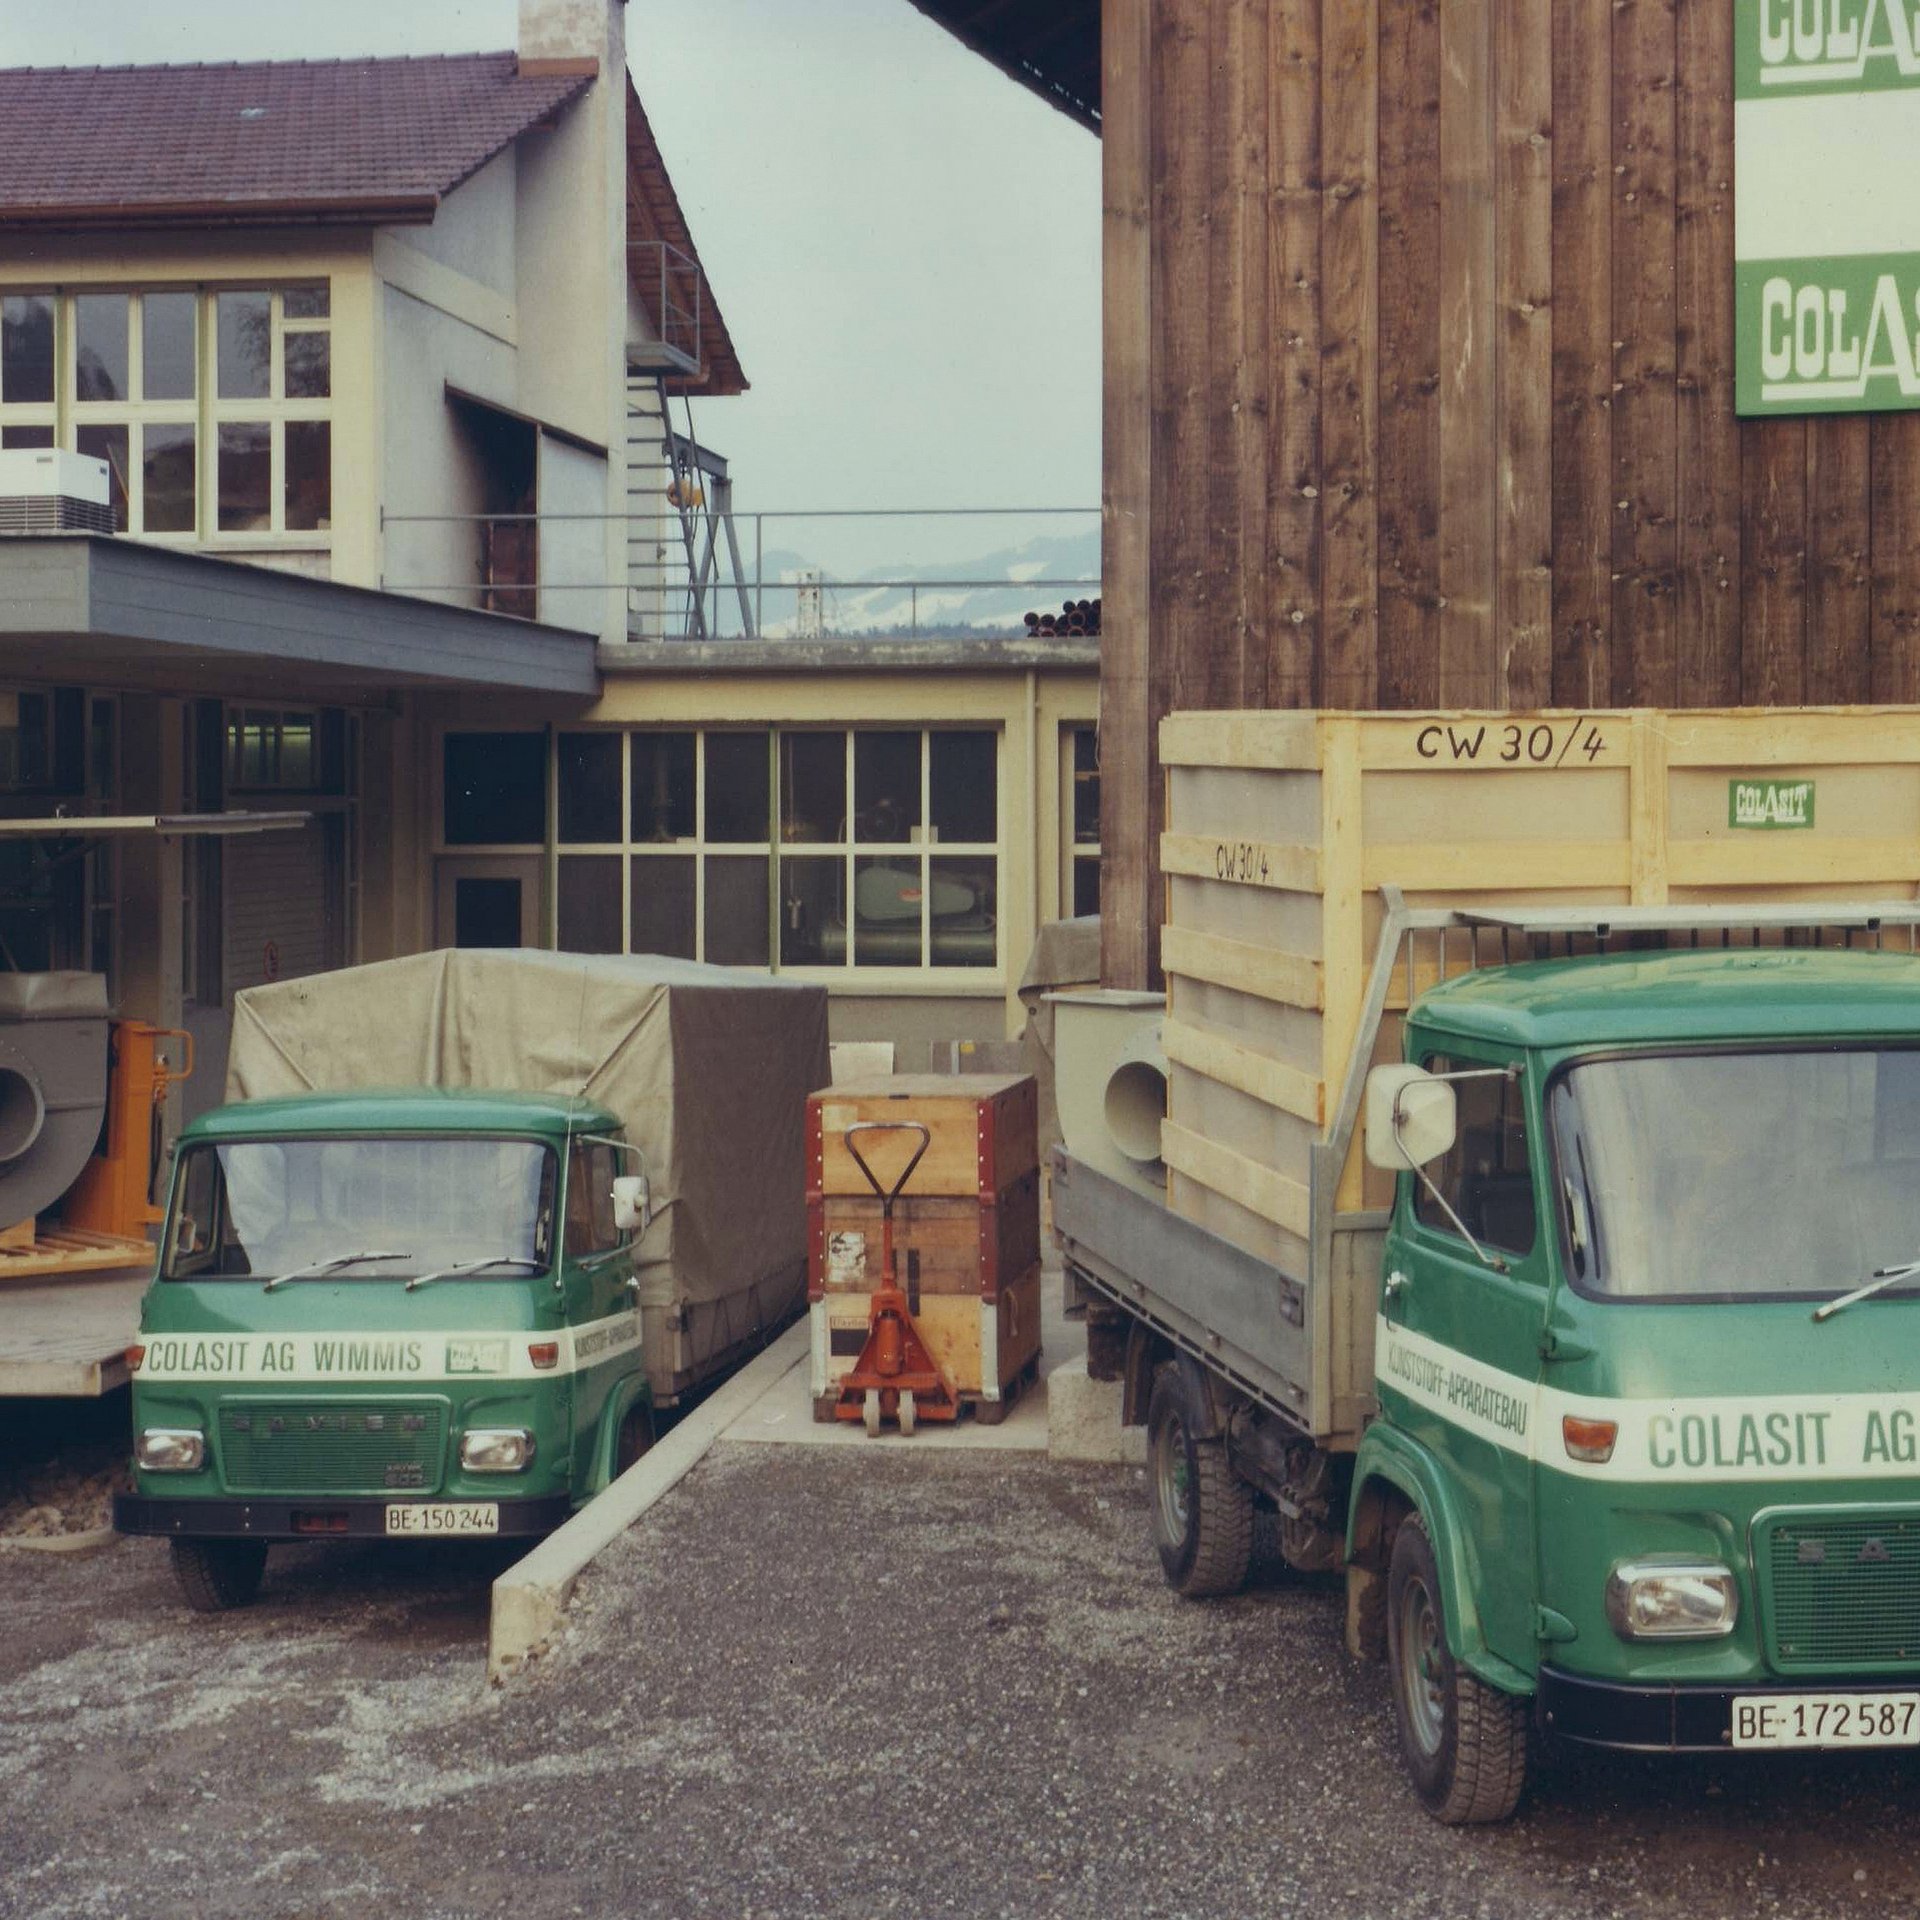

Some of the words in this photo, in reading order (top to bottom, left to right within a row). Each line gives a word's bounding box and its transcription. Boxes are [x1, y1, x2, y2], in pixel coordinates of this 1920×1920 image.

[1760, 0, 1920, 84] COLA
[1761, 274, 1920, 400] COLA
[1416, 725, 1485, 759] CW
[1500, 717, 1607, 768] 30/4
[1736, 784, 1808, 823] COLASIT
[1216, 843, 1236, 879] CW
[148, 1340, 249, 1373] COLASIT
[260, 1341, 295, 1373] AG
[313, 1340, 422, 1373] WIMMIS
[1648, 1411, 1831, 1468] COLASIT
[1862, 1409, 1917, 1463] AG
